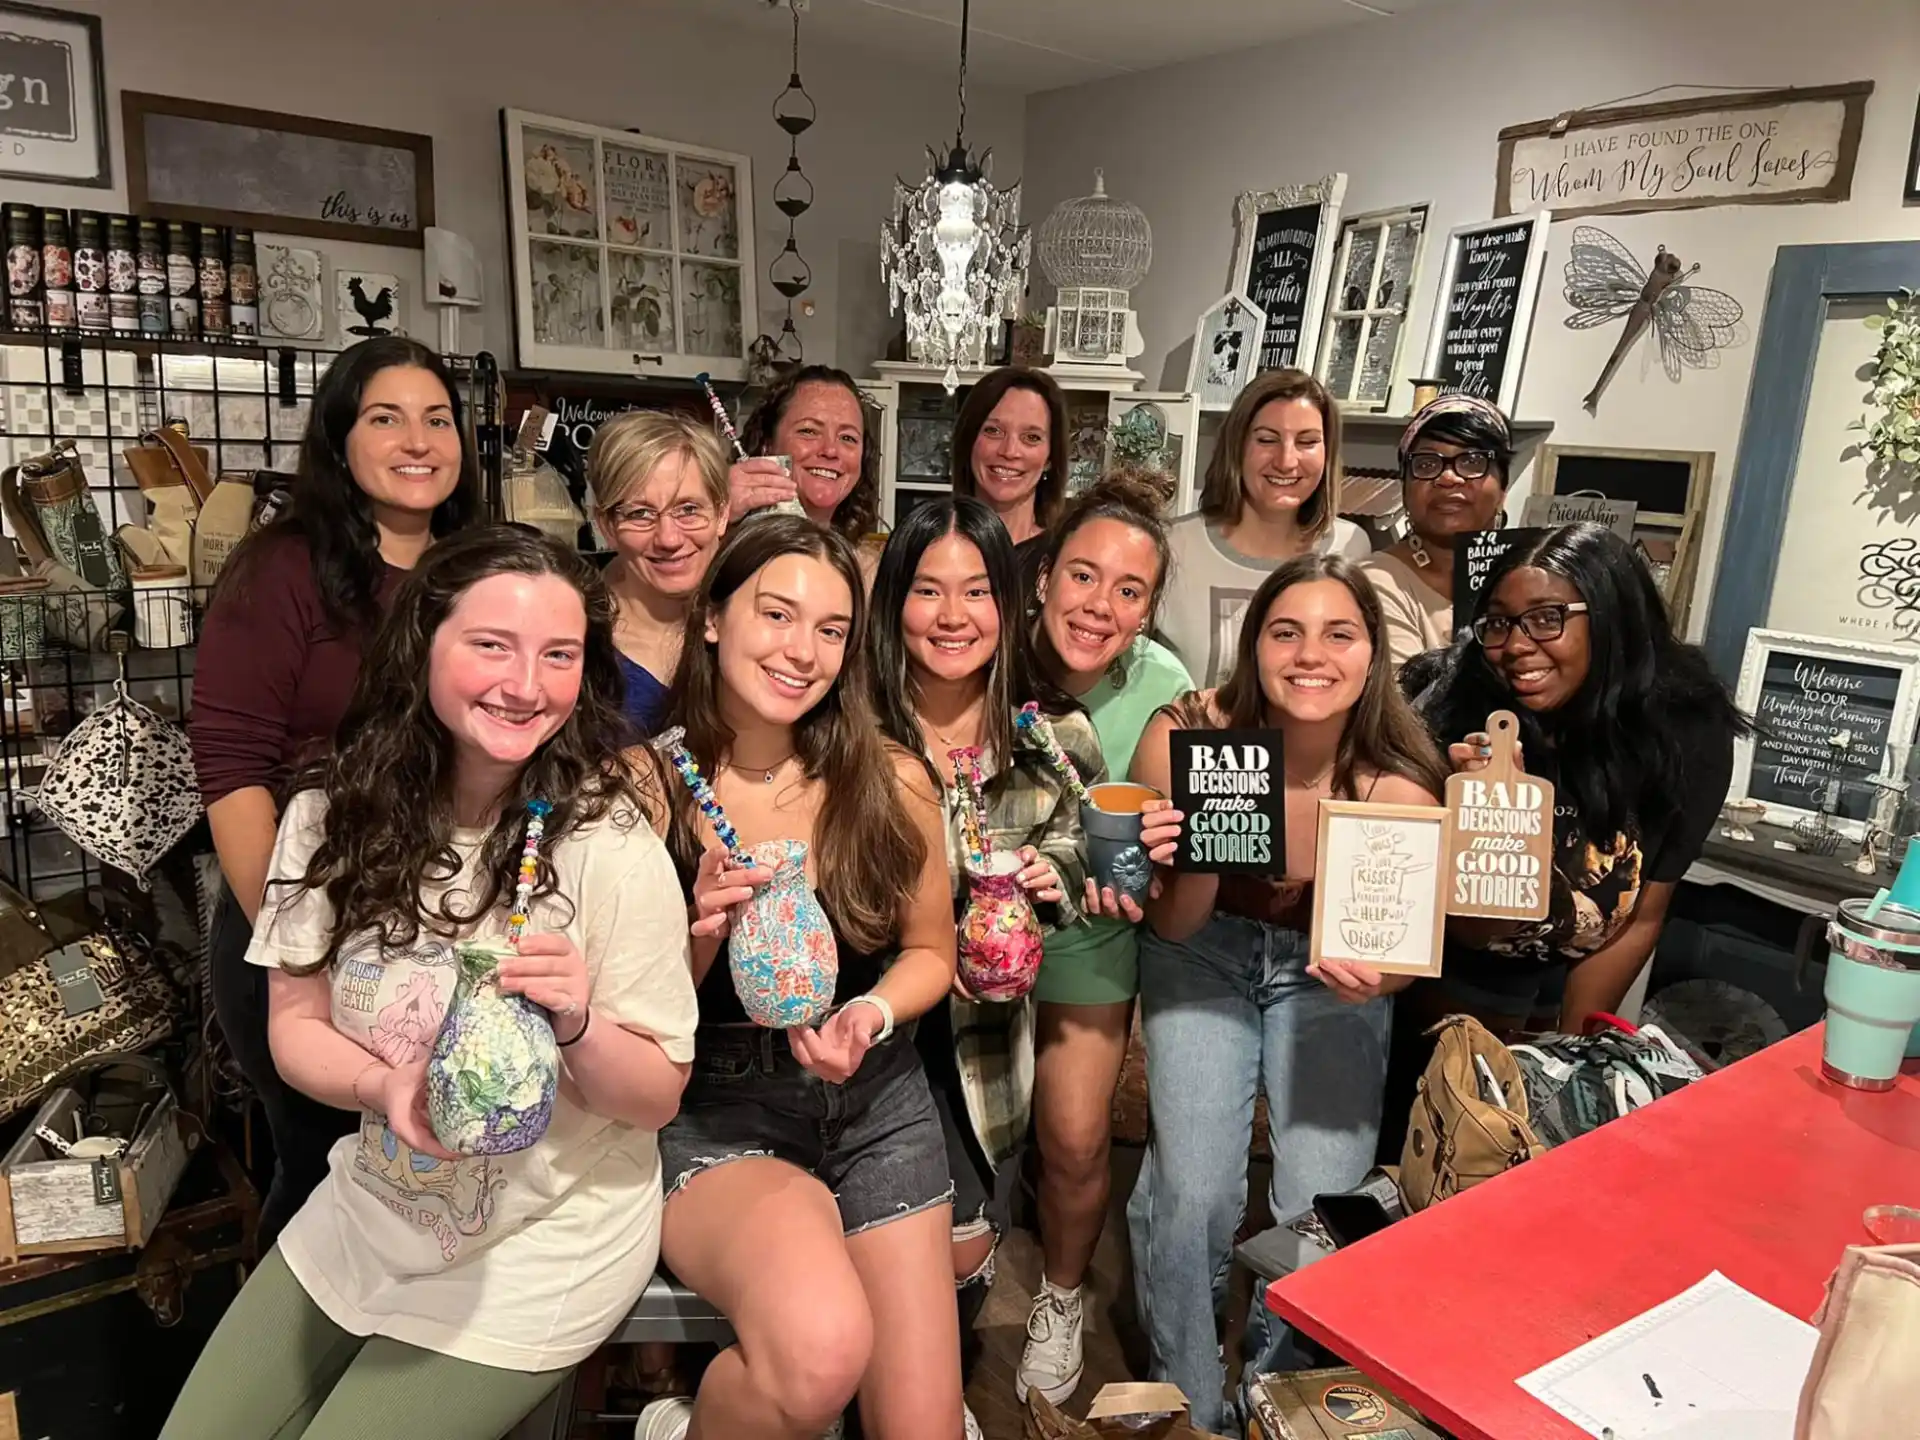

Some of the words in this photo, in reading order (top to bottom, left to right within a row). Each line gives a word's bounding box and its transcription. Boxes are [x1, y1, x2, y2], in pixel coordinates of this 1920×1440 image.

[1563, 145, 1568, 159] I
[1574, 136, 1618, 158] HAVE
[1627, 128, 1689, 149] FOUND
[1696, 125, 1733, 142] THE
[1739, 120, 1780, 139] ONE
[1513, 162, 1605, 202] Whom
[1612, 149, 1668, 197] My
[1672, 142, 1742, 192] Soul
[1748, 138, 1838, 188] Loves
[318, 190, 361, 223] this
[368, 206, 385, 226] is
[388, 211, 412, 229] us
[1269, 250, 1294, 268] ALL
[1492, 276, 1516, 289] room
[1263, 328, 1297, 344] ETHER
[556, 396, 614, 422] Welcom
[1547, 501, 1619, 525] Friendship
[203, 538, 224, 552] MORE
[1467, 543, 1512, 560] BALANC
[1839, 616, 1879, 629] WHERE
[1794, 661, 1864, 690] Welcome
[1762, 695, 1828, 721] Unplugged
[1804, 689, 1819, 702] TO
[1821, 692, 1848, 706] OUR
[1772, 717, 1801, 730] PLEASE
[1803, 722, 1828, 734] TURN
[1188, 744, 1270, 771] BAD
[1762, 739, 1783, 750] AND
[1784, 742, 1810, 755] ENJOY
[1812, 747, 1832, 759] THIS
[1814, 738, 1828, 746] AN
[1854, 743, 1880, 755] ERAS
[1781, 754, 1800, 766] DAY
[1801, 758, 1825, 770] WITH
[1188, 771, 1270, 795] DECISIONS
[1769, 765, 1815, 787] Thank
[1202, 794, 1258, 812] make
[1459, 779, 1543, 811] BAD
[1189, 811, 1271, 834] GOOD
[1458, 807, 1542, 836] DECISIONS
[1190, 833, 1271, 864] STORIES
[1470, 833, 1527, 853] make
[1456, 850, 1540, 877] GOOD
[1454, 872, 1540, 909] STORIES
[1360, 905, 1388, 921] HELP
[345, 960, 386, 981] MUSIC
